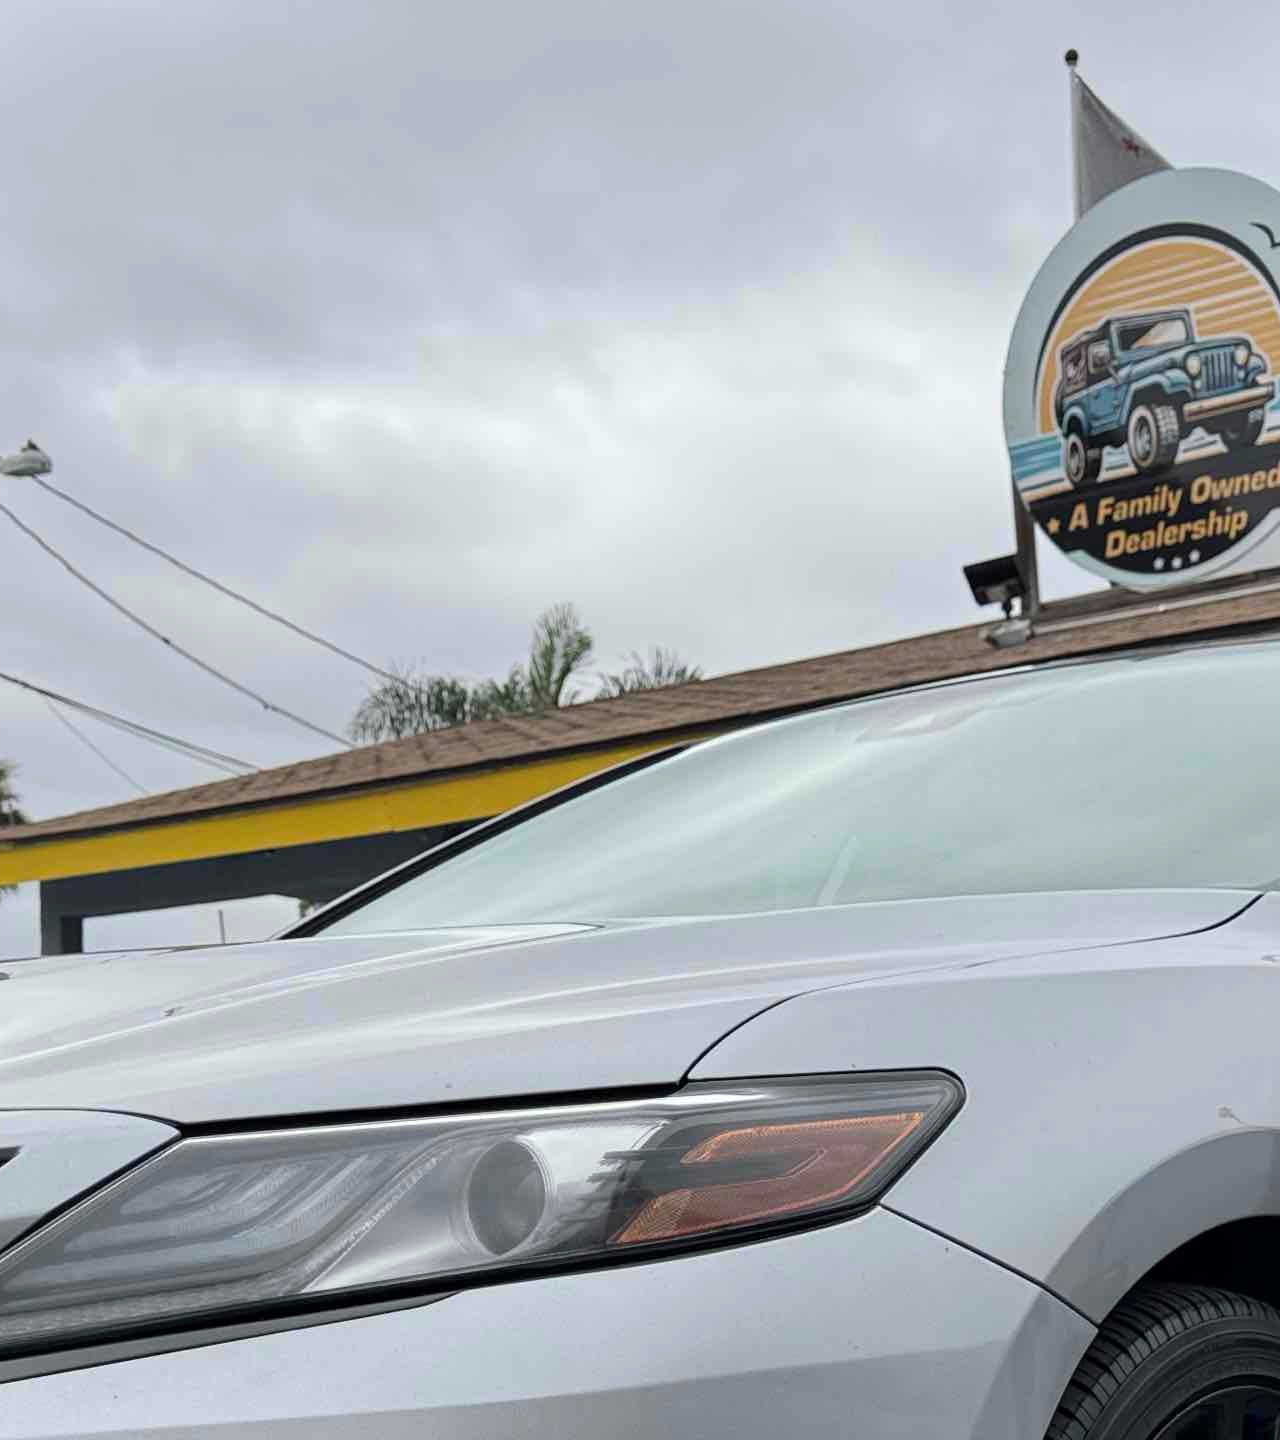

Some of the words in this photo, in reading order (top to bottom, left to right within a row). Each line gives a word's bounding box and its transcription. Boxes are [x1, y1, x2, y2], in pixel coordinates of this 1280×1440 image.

[1068, 502, 1089, 531] A
[1096, 484, 1183, 526] Family
[1104, 507, 1249, 559] Dealership
